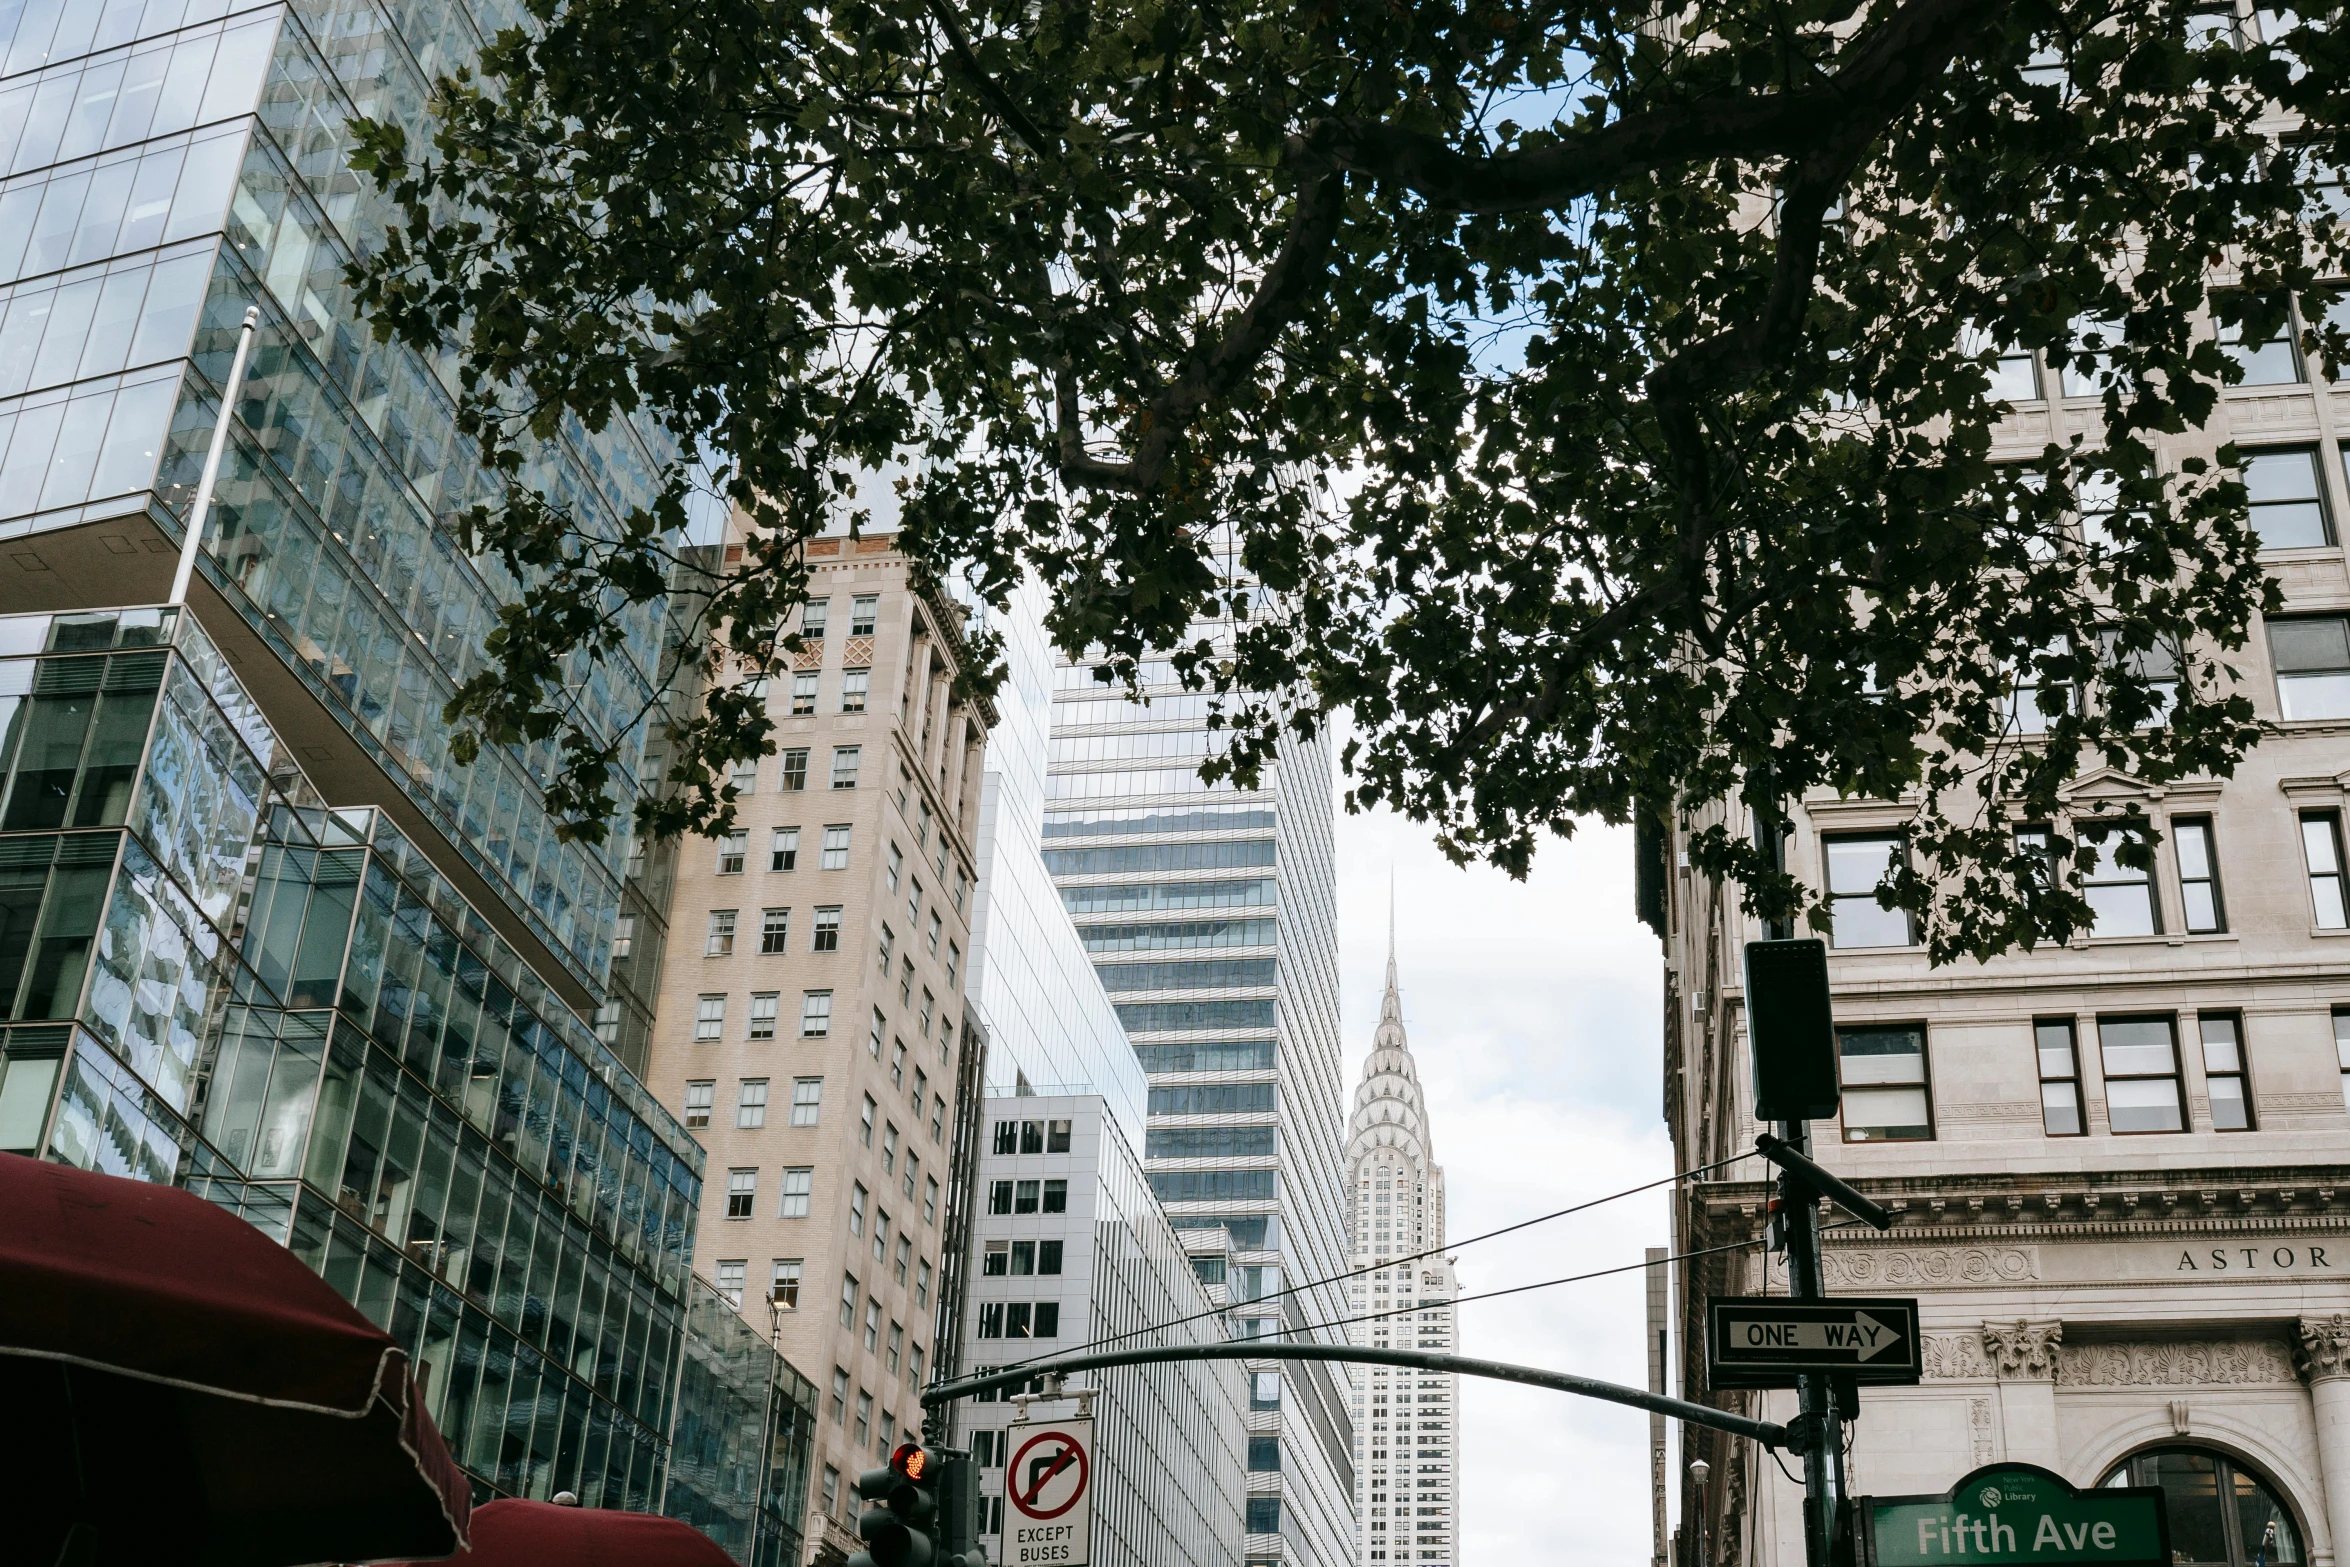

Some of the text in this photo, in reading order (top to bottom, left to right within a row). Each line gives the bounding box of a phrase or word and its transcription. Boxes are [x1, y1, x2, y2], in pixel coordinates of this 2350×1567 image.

[2177, 1247, 2331, 1270] ASTOR
[1747, 1324, 1881, 1347] ONE WAY
[2003, 1474, 2036, 1484] New York
[2003, 1484, 2024, 1492] Public
[2004, 1492, 2037, 1503] Library
[1018, 1526, 1073, 1543] EXCEPT
[1917, 1513, 2116, 1554] Fifth Ave
[1020, 1545, 1069, 1562] BUSES
